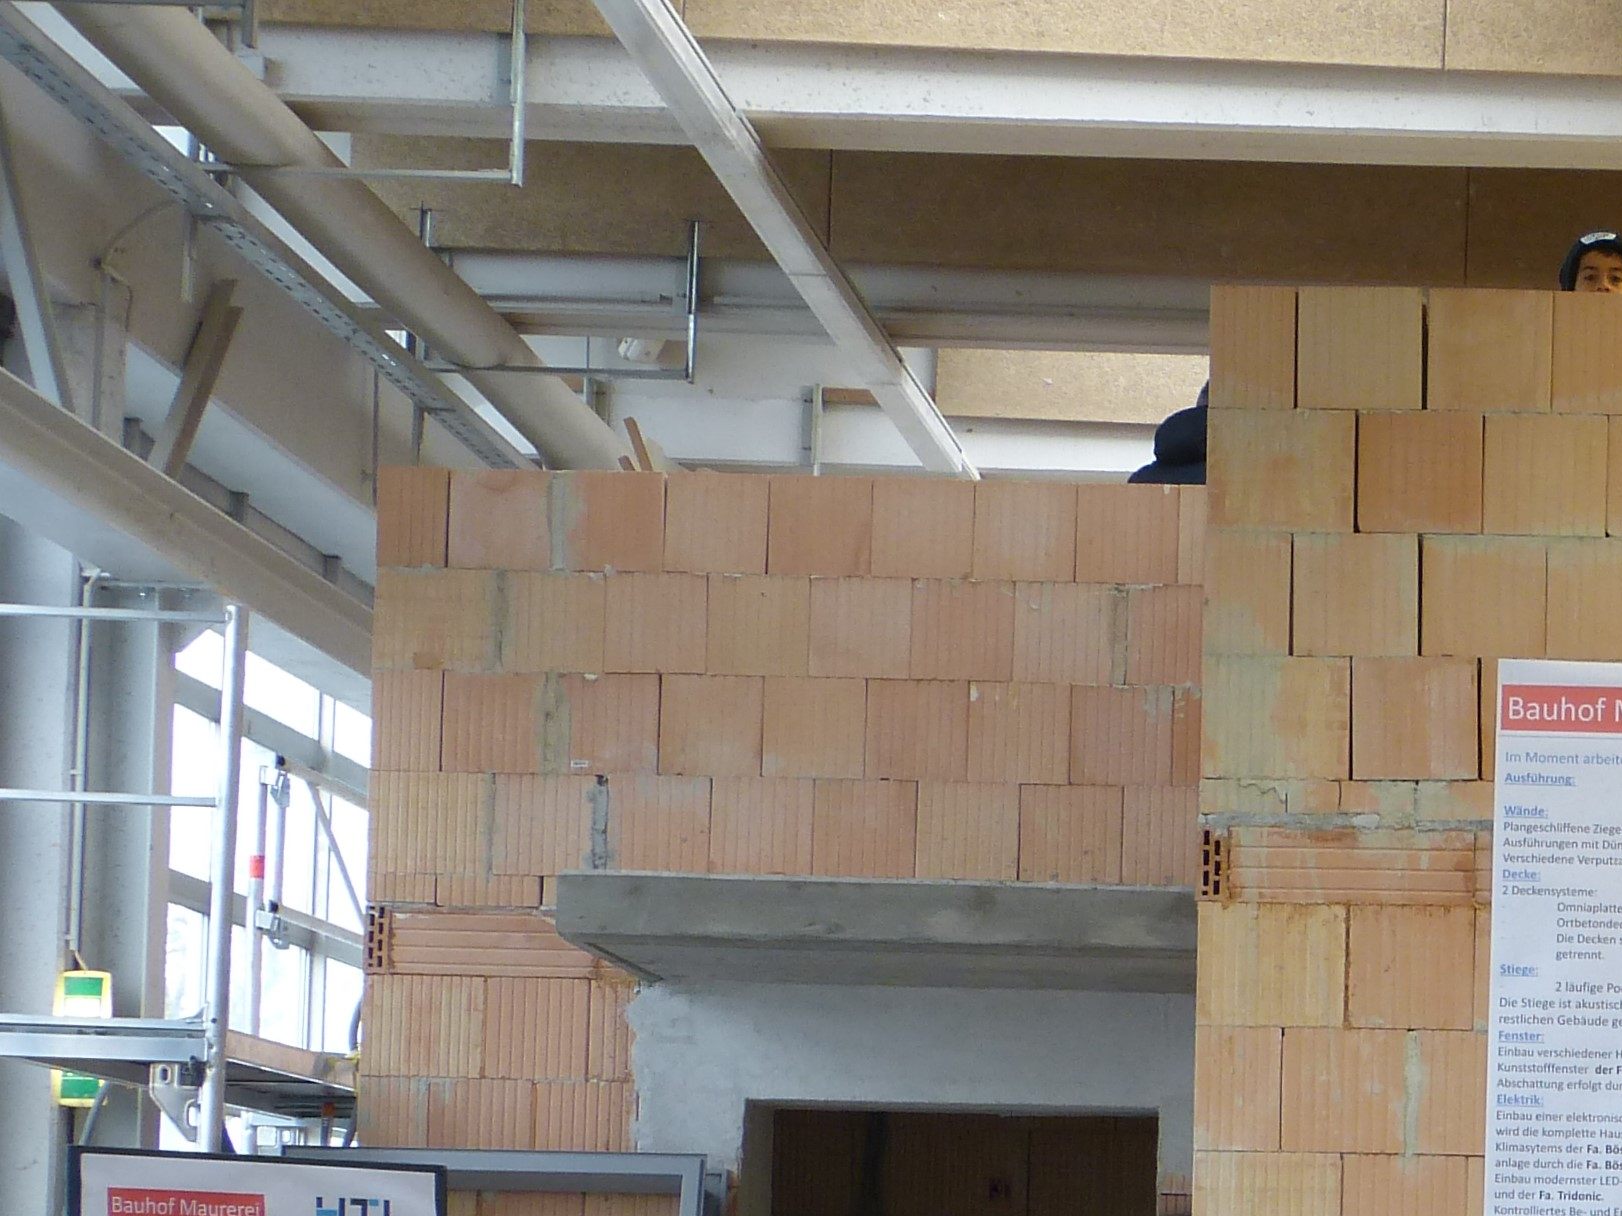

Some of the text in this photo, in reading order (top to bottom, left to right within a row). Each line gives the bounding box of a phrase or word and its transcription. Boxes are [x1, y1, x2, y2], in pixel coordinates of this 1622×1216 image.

[1507, 697, 1607, 723] Bauhof
[1505, 750, 1521, 762] Im
[1525, 751, 1578, 764] Moment
[1503, 836, 1578, 850] Ausführungen
[1581, 838, 1598, 849] mit
[1502, 852, 1574, 864] Verschiedene
[1556, 933, 1573, 943] Die
[1577, 933, 1616, 944] Decken
[1499, 996, 1517, 1007] Die
[1521, 997, 1555, 1010] Stiege
[1558, 998, 1571, 1008] ist
[1498, 1013, 1608, 1026] restlichen Gebäude
[1498, 1046, 1533, 1056] Einbau
[1537, 1047, 1612, 1058] verschiedener
[1594, 1064, 1613, 1074] der
[1497, 1077, 1563, 1091] Abschattung
[1566, 1079, 1601, 1092] erfolgt
[1496, 1110, 1532, 1120] Einbau
[1535, 1111, 1562, 1121] einer
[1495, 1126, 1519, 1136] wird
[1522, 1126, 1538, 1136] die
[1541, 1127, 1595, 1140] komplette
[1565, 1143, 1582, 1153] der
[1494, 1157, 1530, 1170] anlage
[1532, 1158, 1563, 1168] durch
[1566, 1159, 1582, 1169] die
[1494, 1173, 1530, 1183] Einbau
[1533, 1173, 1595, 1185] modernster
[1494, 1188, 1514, 1198] und
[1517, 1189, 1534, 1199] der
[111, 1196, 175, 1216] Bauhof
[1493, 1204, 1565, 1216] Kontrolliertes
[1589, 1206, 1610, 1216] und
